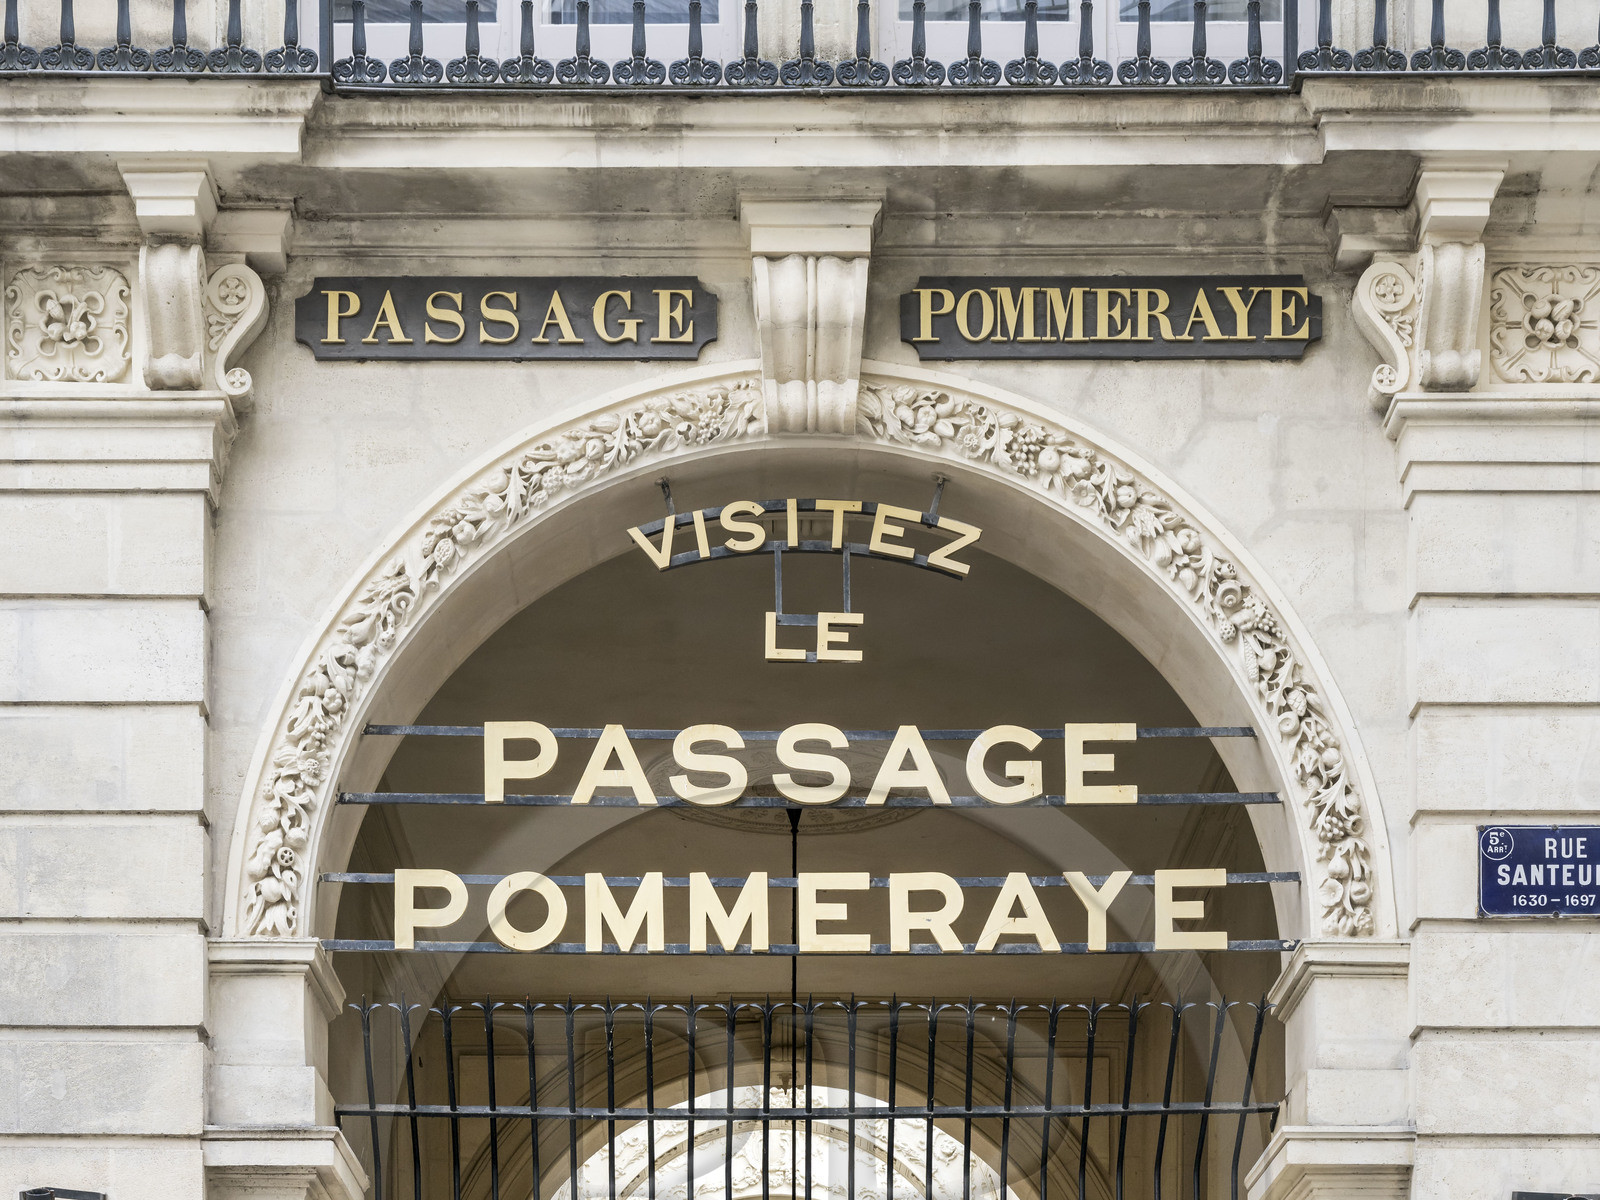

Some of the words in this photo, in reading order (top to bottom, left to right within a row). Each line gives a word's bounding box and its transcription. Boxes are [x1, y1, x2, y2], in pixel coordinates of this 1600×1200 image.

[320, 289, 695, 344] PASSAGE
[912, 286, 1310, 342] POMMERAYE
[626, 498, 983, 577] VISITEZ
[764, 611, 865, 662] LE
[483, 720, 1139, 806] PASSAGE
[1544, 837, 1588, 859] RUE
[394, 867, 1229, 954] POMMERAYE
[1512, 894, 1548, 907] 1630
[1564, 894, 1597, 907] 1697
